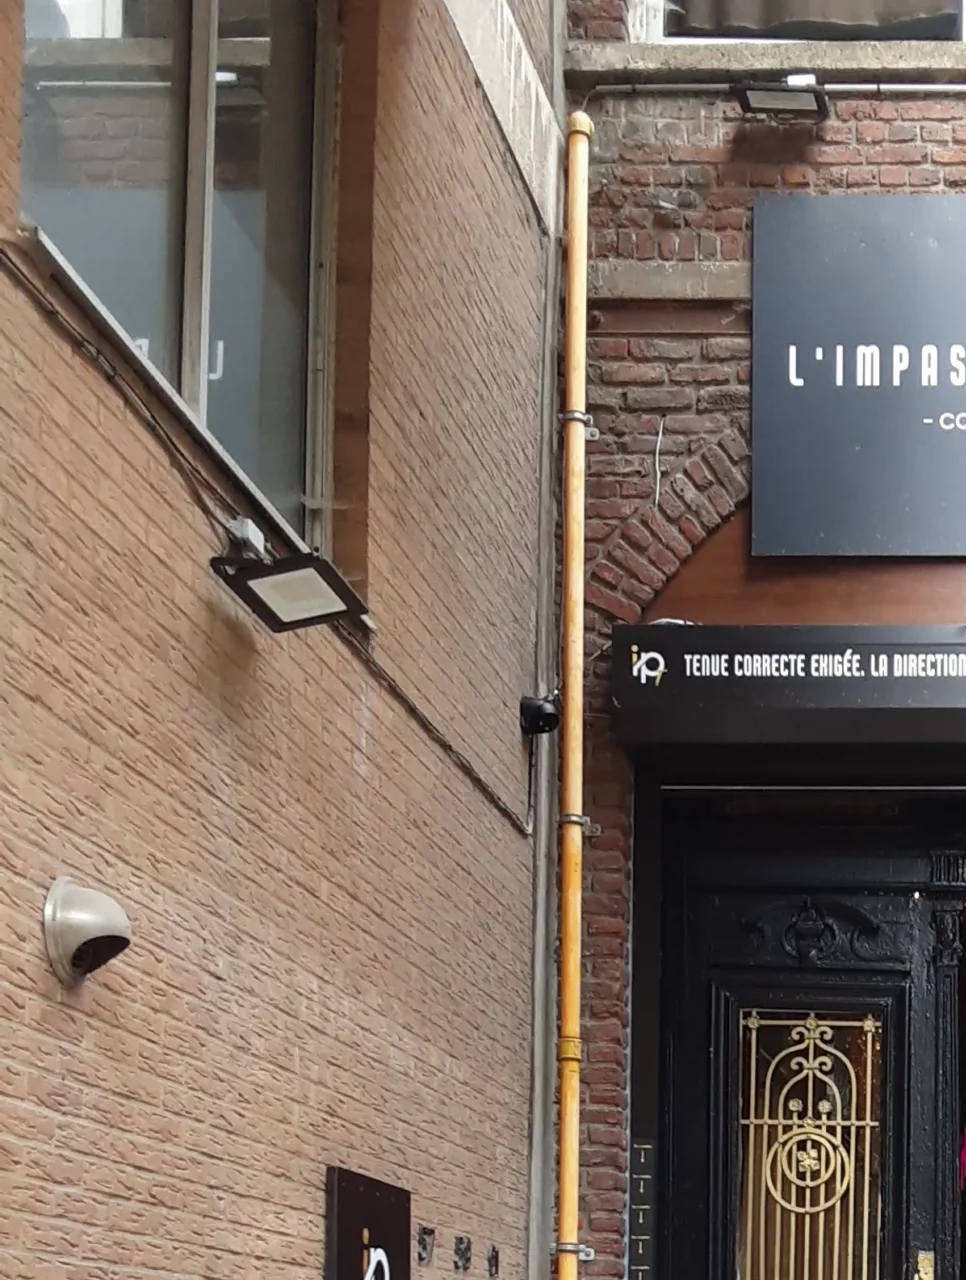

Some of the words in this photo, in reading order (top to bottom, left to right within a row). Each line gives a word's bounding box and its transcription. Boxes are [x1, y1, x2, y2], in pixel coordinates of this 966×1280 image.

[684, 653, 729, 677] TENUE
[734, 653, 806, 677] CORRECTE
[870, 653, 888, 677] LA
